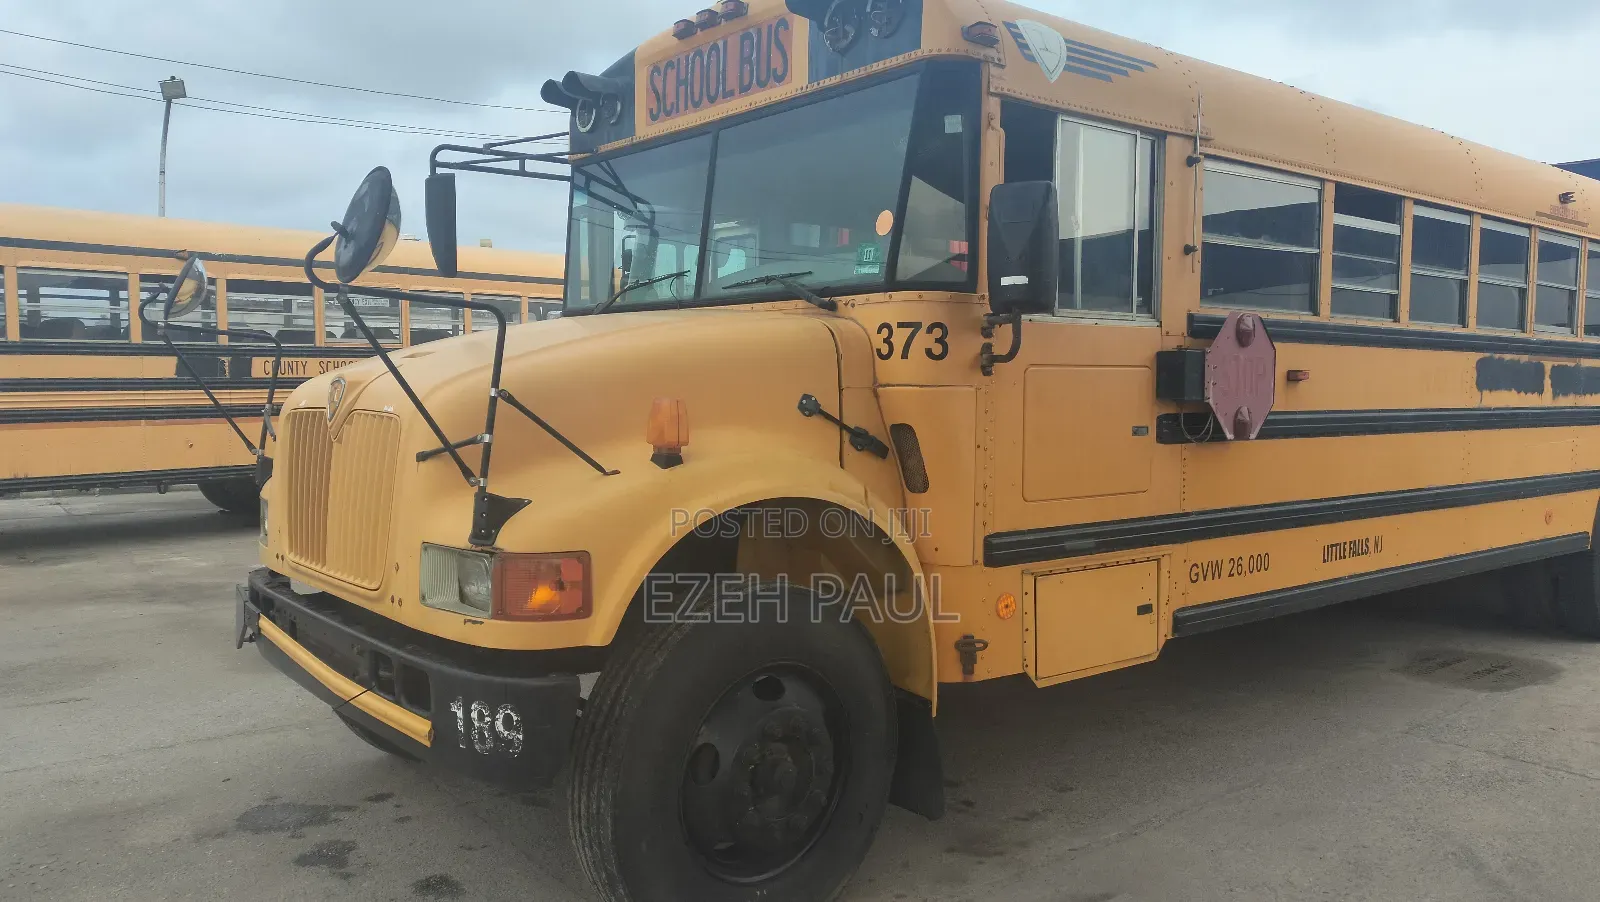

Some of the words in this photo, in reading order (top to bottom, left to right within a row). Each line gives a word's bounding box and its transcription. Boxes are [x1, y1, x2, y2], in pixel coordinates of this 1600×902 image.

[648, 39, 735, 122] SCHOOL
[738, 17, 790, 95] BUS
[875, 321, 949, 361] 373
[1219, 354, 1267, 399] STOP
[1189, 559, 1224, 584] GVW
[1227, 552, 1270, 578] 26,000
[1322, 541, 1347, 564] LITTLE
[1373, 535, 1383, 554] NJ
[449, 695, 524, 758] 189
